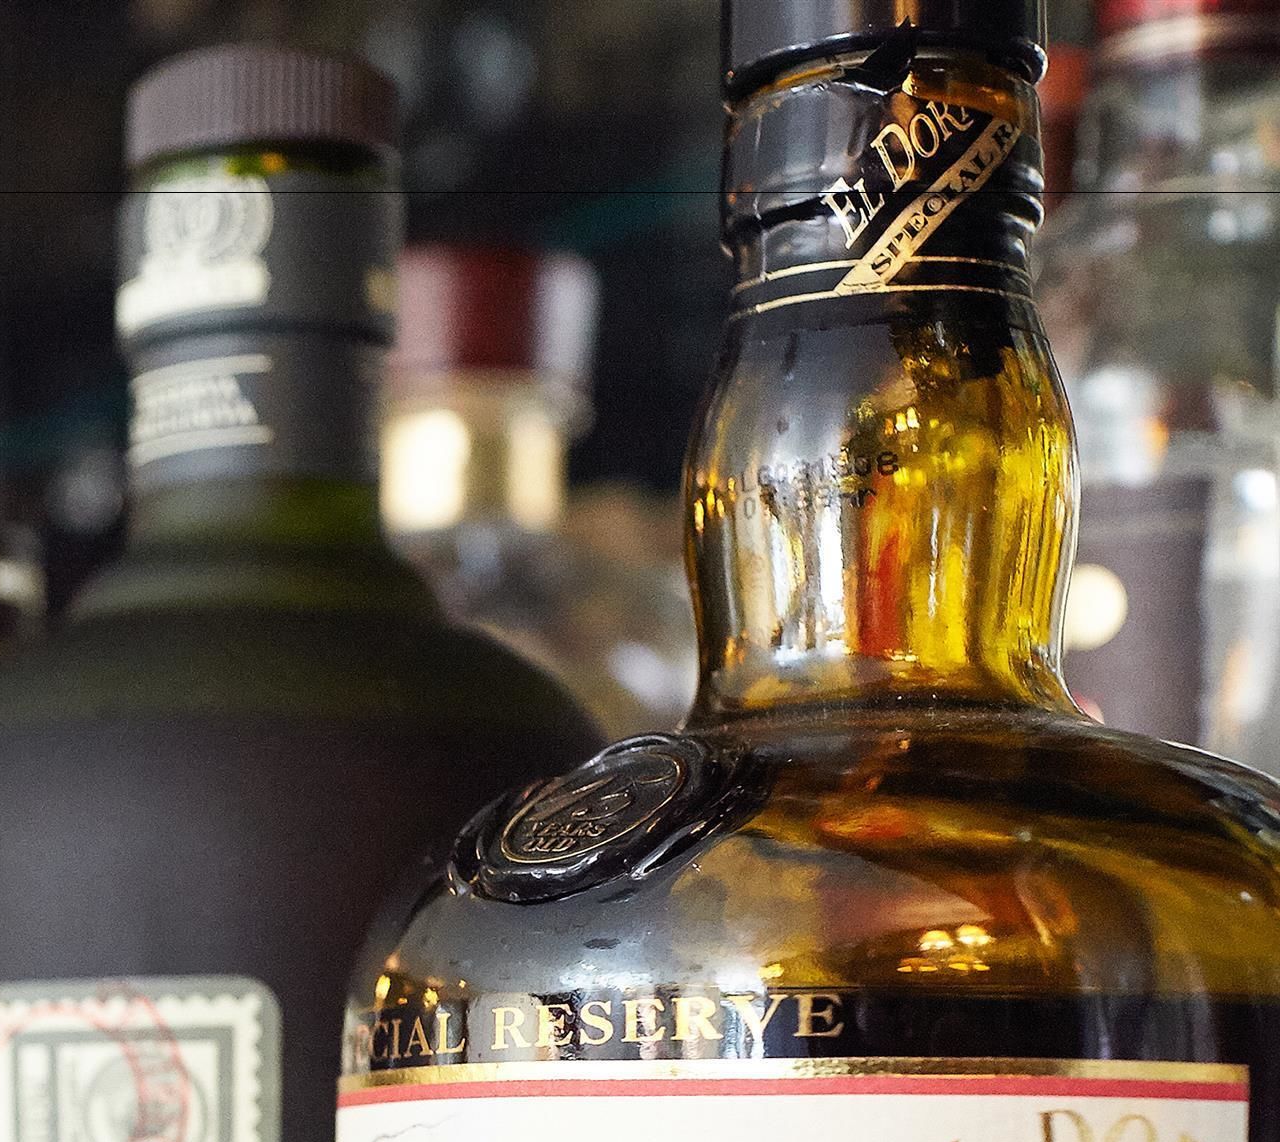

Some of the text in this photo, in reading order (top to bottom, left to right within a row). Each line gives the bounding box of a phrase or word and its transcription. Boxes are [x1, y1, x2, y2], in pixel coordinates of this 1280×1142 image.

[820, 176, 886, 250] EL
[871, 151, 994, 275] SPECIAL
[490, 993, 846, 1051] RESERVE
